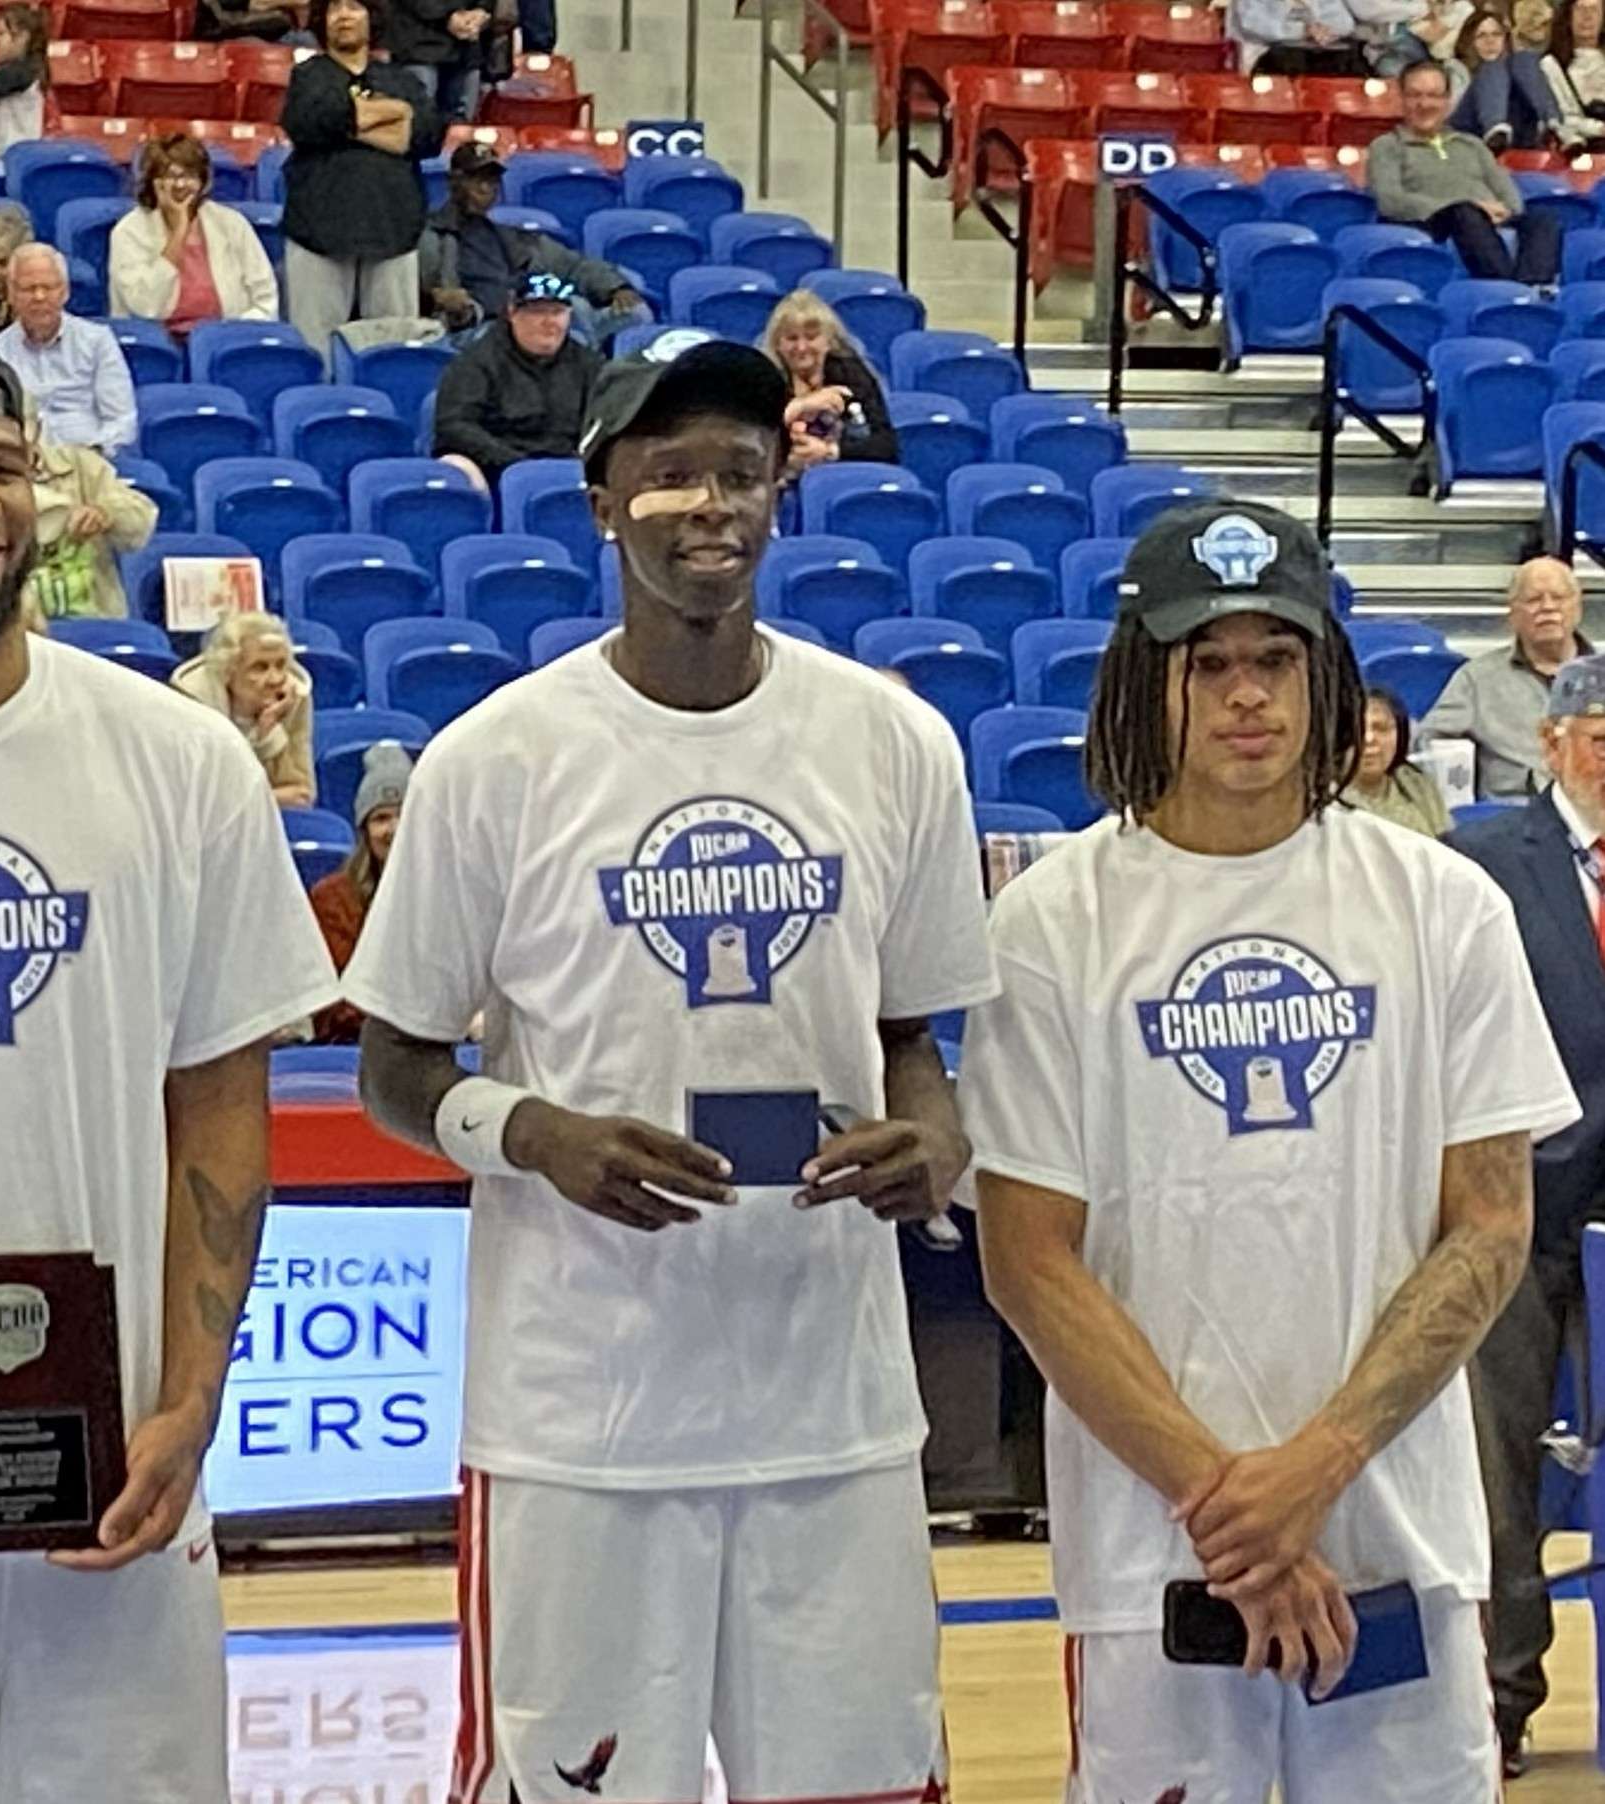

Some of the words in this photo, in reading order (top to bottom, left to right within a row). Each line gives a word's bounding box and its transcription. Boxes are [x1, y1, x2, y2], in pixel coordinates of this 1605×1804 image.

[628, 129, 703, 157] CC
[1102, 142, 1176, 175] DD
[648, 804, 789, 855] NATIONAL
[622, 860, 825, 919] CHAMPIONS
[1184, 942, 1321, 989] NATIONAL
[1160, 989, 1358, 1051] CHAMPIONS
[239, 1392, 430, 1457] ERS
